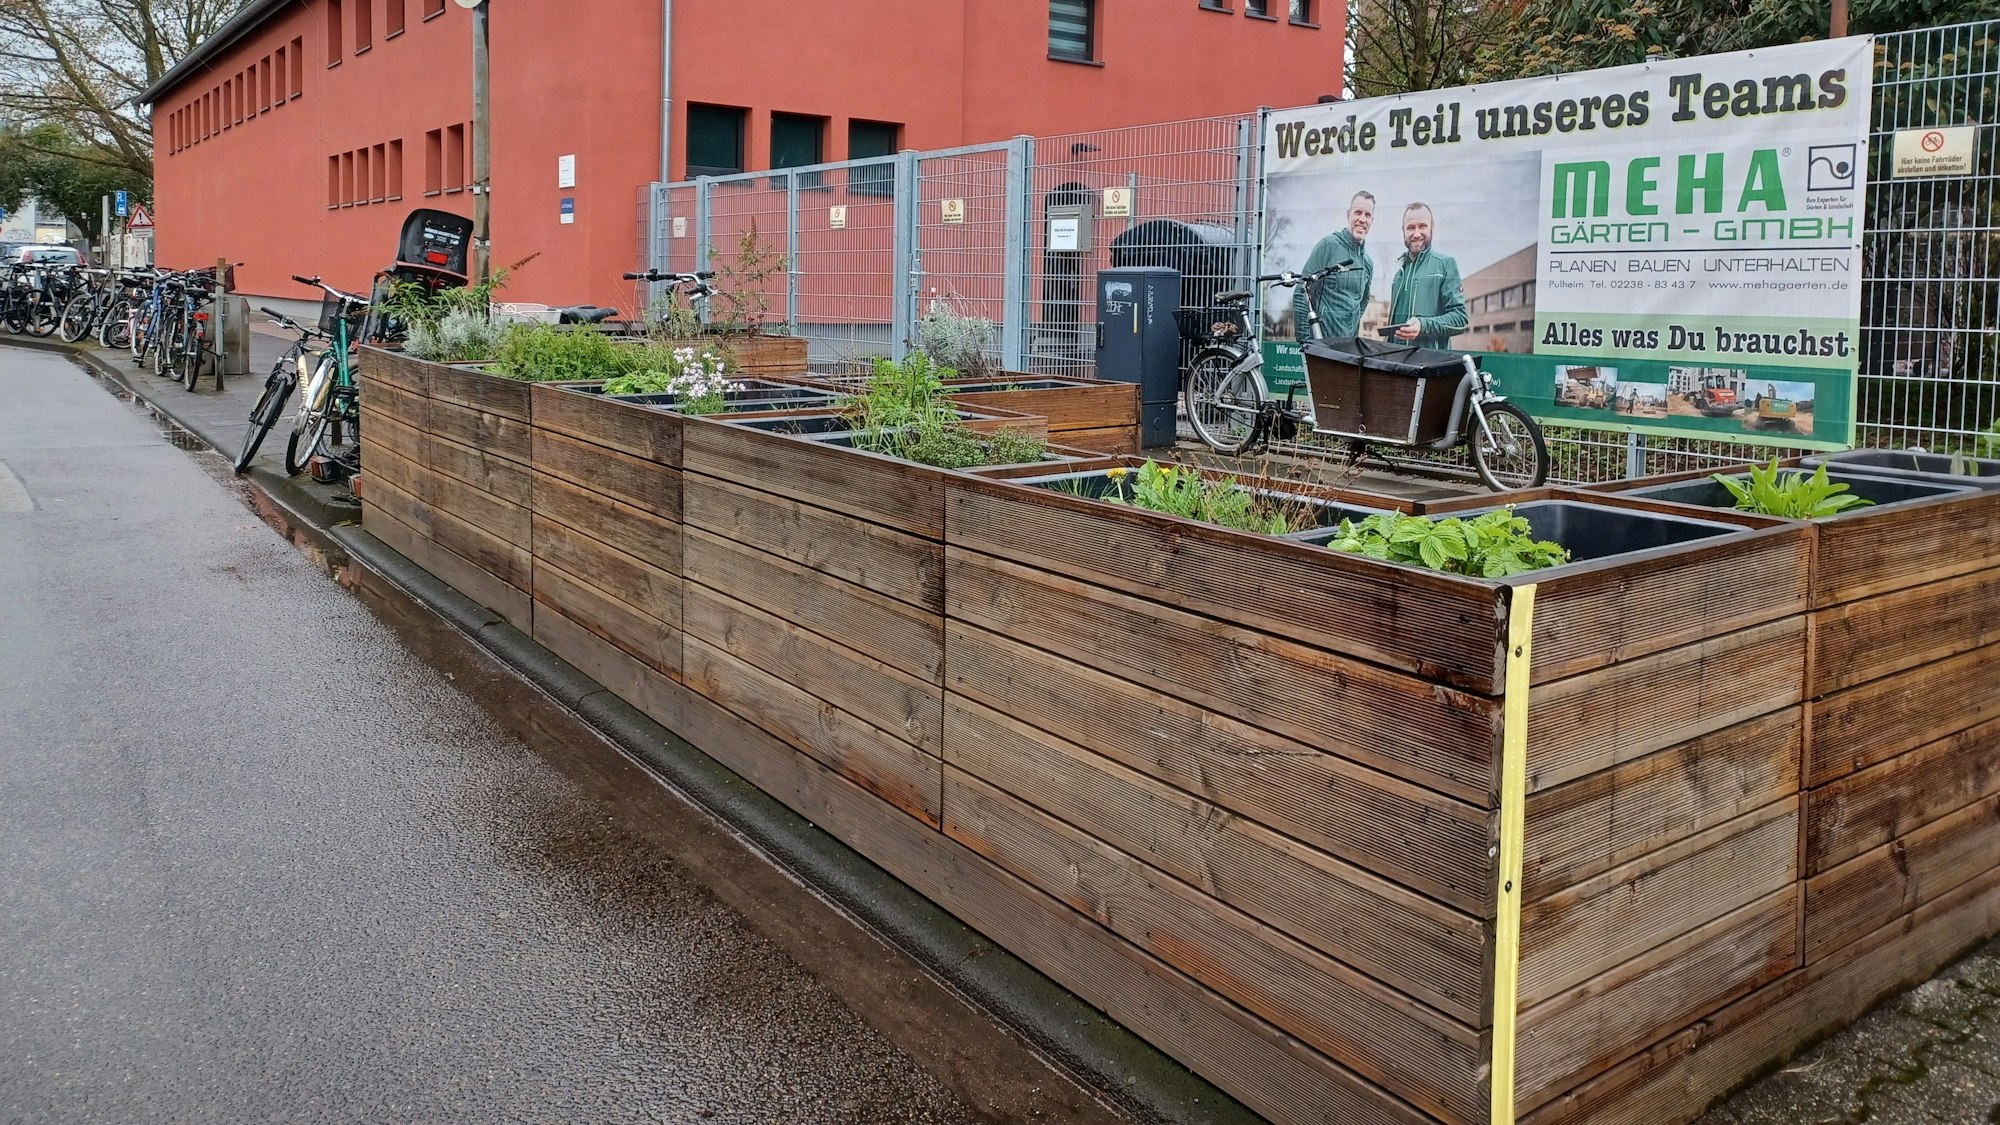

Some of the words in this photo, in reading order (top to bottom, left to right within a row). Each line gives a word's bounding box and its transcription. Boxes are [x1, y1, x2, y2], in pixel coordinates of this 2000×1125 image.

[1275, 116, 1376, 158] Werde
[1389, 102, 1461, 148] Teil
[1475, 90, 1649, 139] unseres
[1669, 68, 1846, 122] Teams
[1901, 157, 1913, 165] Hier
[1914, 156, 1930, 164] keine
[1931, 155, 1962, 163] Fahrräder
[1937, 163, 1966, 171] anketten!
[1551, 149, 1787, 218] MEHA
[1817, 196, 1838, 204] Experten
[1551, 220, 1669, 244] GÄRTEN
[1713, 216, 1853, 241] GMBH
[1549, 260, 1617, 272] PLANEN
[1628, 259, 1691, 272] BAUEN
[1703, 257, 1850, 272] UNTERHALTEN
[1548, 280, 1584, 289] Pulheim
[1590, 280, 1607, 289] Tel.
[1610, 280, 1644, 289] 02238
[1654, 280, 1668, 289] 83
[1671, 280, 1685, 289] 43
[1690, 280, 1696, 289] 7
[1709, 280, 1848, 291] www.mehagaerten.de
[1541, 321, 1603, 347] Alles
[1612, 328, 1659, 350] was
[1667, 325, 1706, 351] Du
[1715, 326, 1850, 358] brauchst
[1276, 344, 1288, 354] Wir
